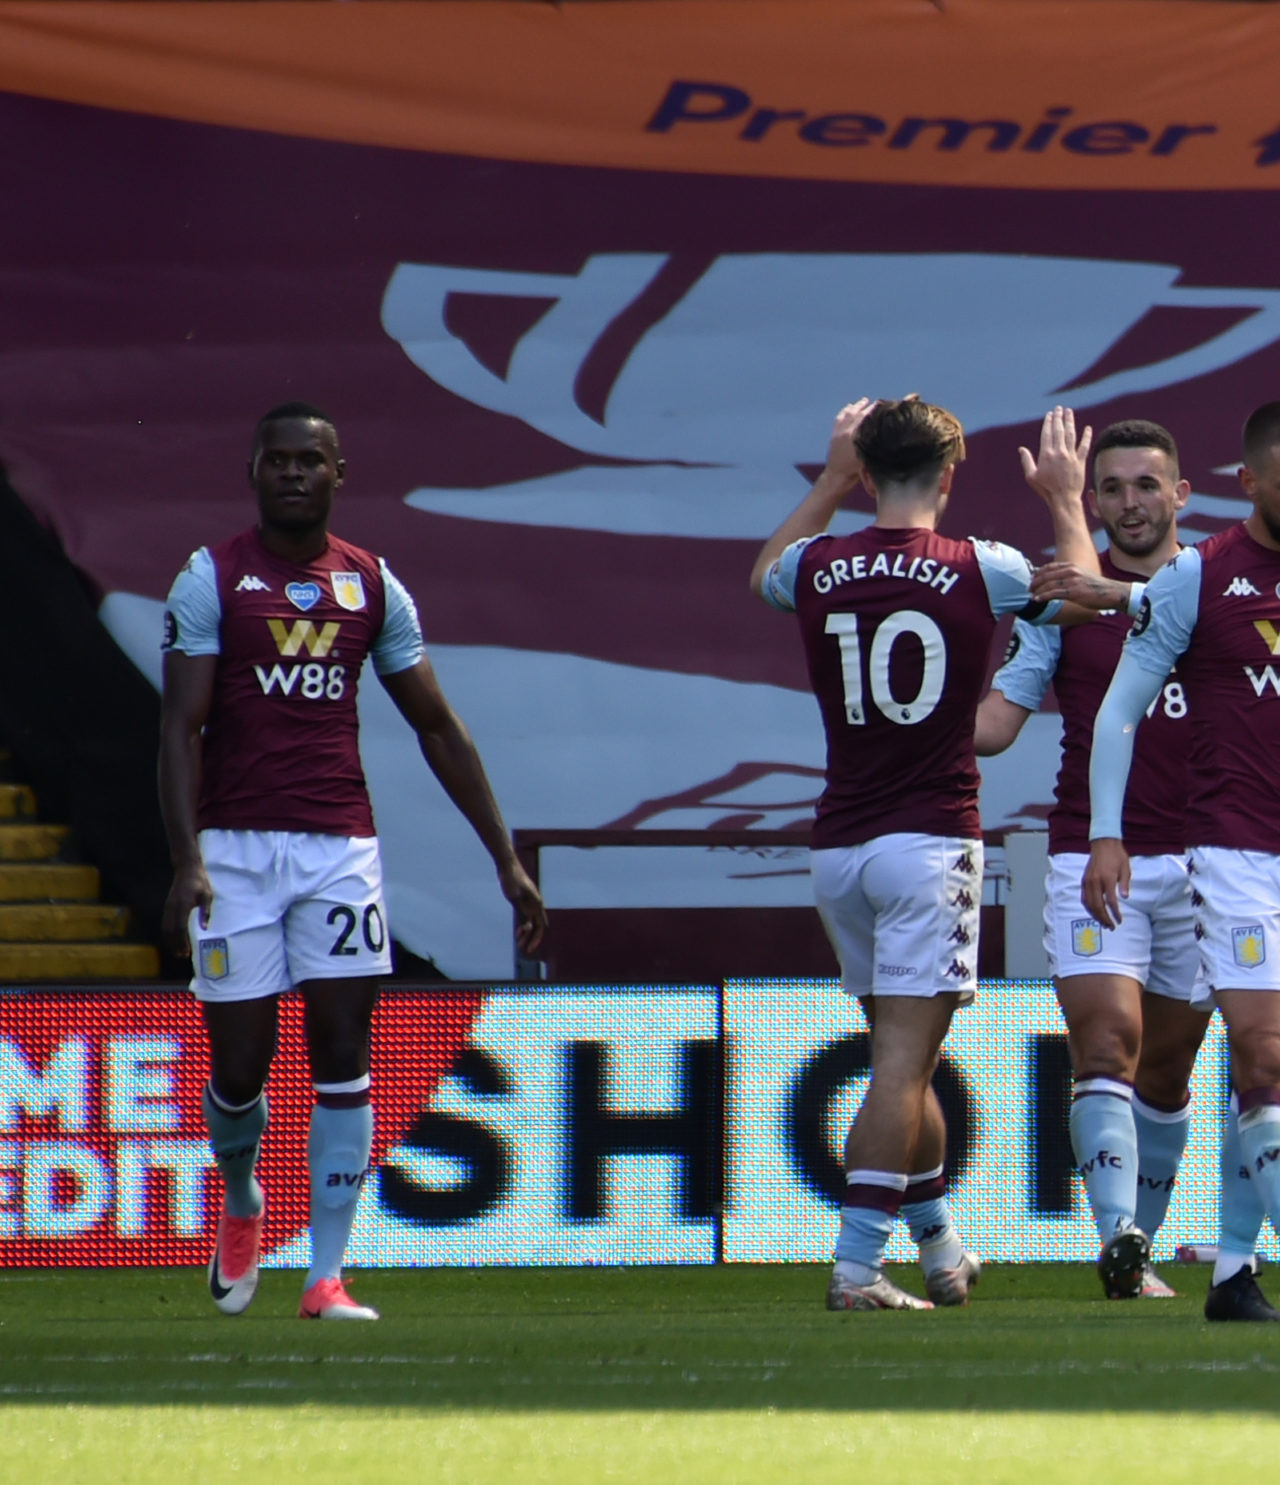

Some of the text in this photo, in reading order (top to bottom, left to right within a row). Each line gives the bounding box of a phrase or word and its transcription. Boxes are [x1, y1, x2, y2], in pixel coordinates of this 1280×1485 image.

[644, 79, 1218, 156] Premier
[813, 553, 960, 595] GREALISH
[253, 664, 345, 700] W88
[824, 609, 946, 725] 10
[326, 903, 384, 956] 20
[0, 1034, 182, 1133] ME
